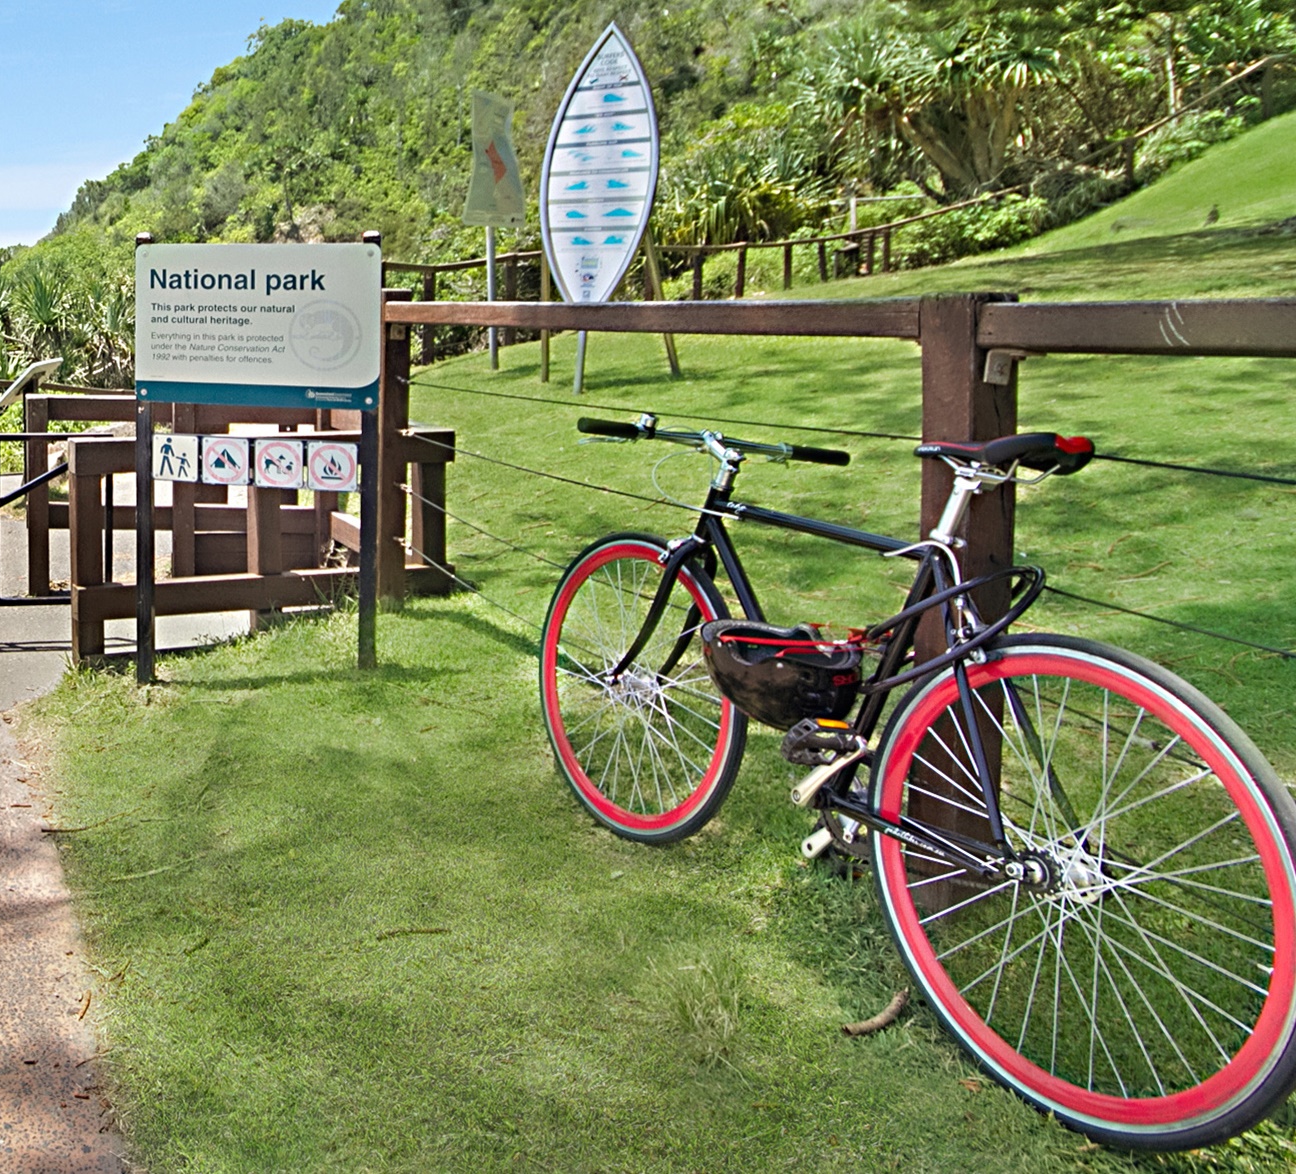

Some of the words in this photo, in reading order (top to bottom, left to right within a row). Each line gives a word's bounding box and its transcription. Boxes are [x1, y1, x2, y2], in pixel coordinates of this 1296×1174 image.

[150, 268, 256, 290] National
[266, 269, 326, 296] park
[151, 303, 171, 311] This
[174, 303, 195, 313] park
[198, 304, 238, 313] protects
[260, 305, 295, 313] natural
[151, 315, 169, 323] and
[171, 316, 207, 324] cultural
[210, 316, 253, 326] heritage.
[151, 332, 191, 341] Everything
[218, 333, 235, 342] park
[246, 334, 284, 342] protected
[189, 343, 216, 351] Nature
[217, 344, 270, 352] Conservation
[271, 345, 286, 353] Act
[189, 354, 223, 363] penalties
[226, 354, 237, 362] for
